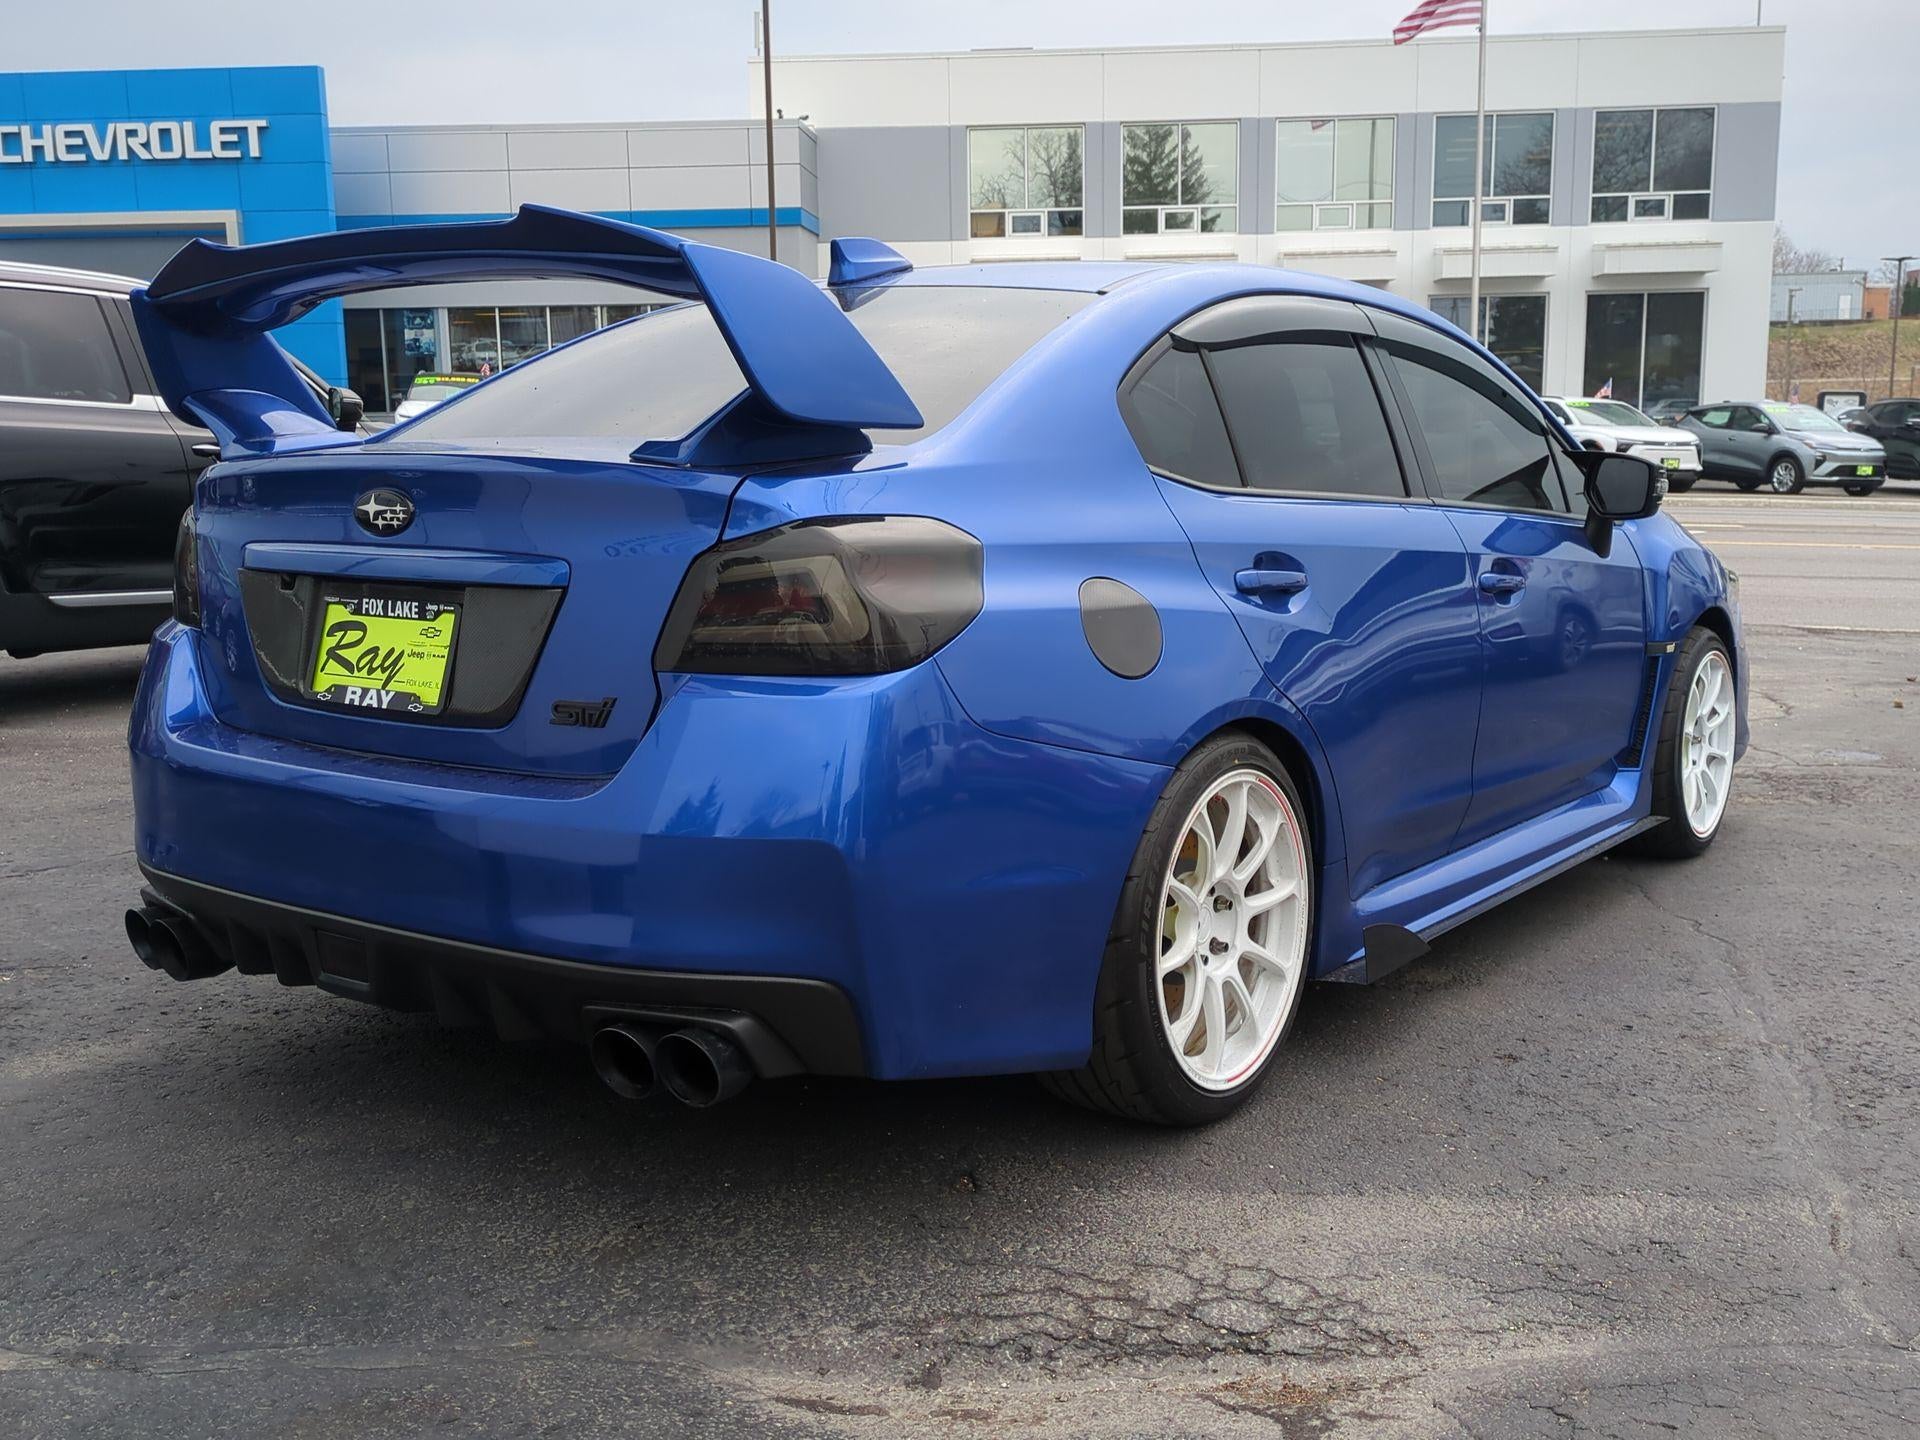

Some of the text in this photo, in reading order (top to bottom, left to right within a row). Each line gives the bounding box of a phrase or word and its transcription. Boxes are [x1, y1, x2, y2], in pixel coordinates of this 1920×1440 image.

[0, 119, 268, 163] CHEVROLET
[362, 598, 419, 619] FOX LAKE
[320, 620, 405, 690] Ray
[407, 649, 425, 660] Jeep
[344, 686, 396, 710] RAY
